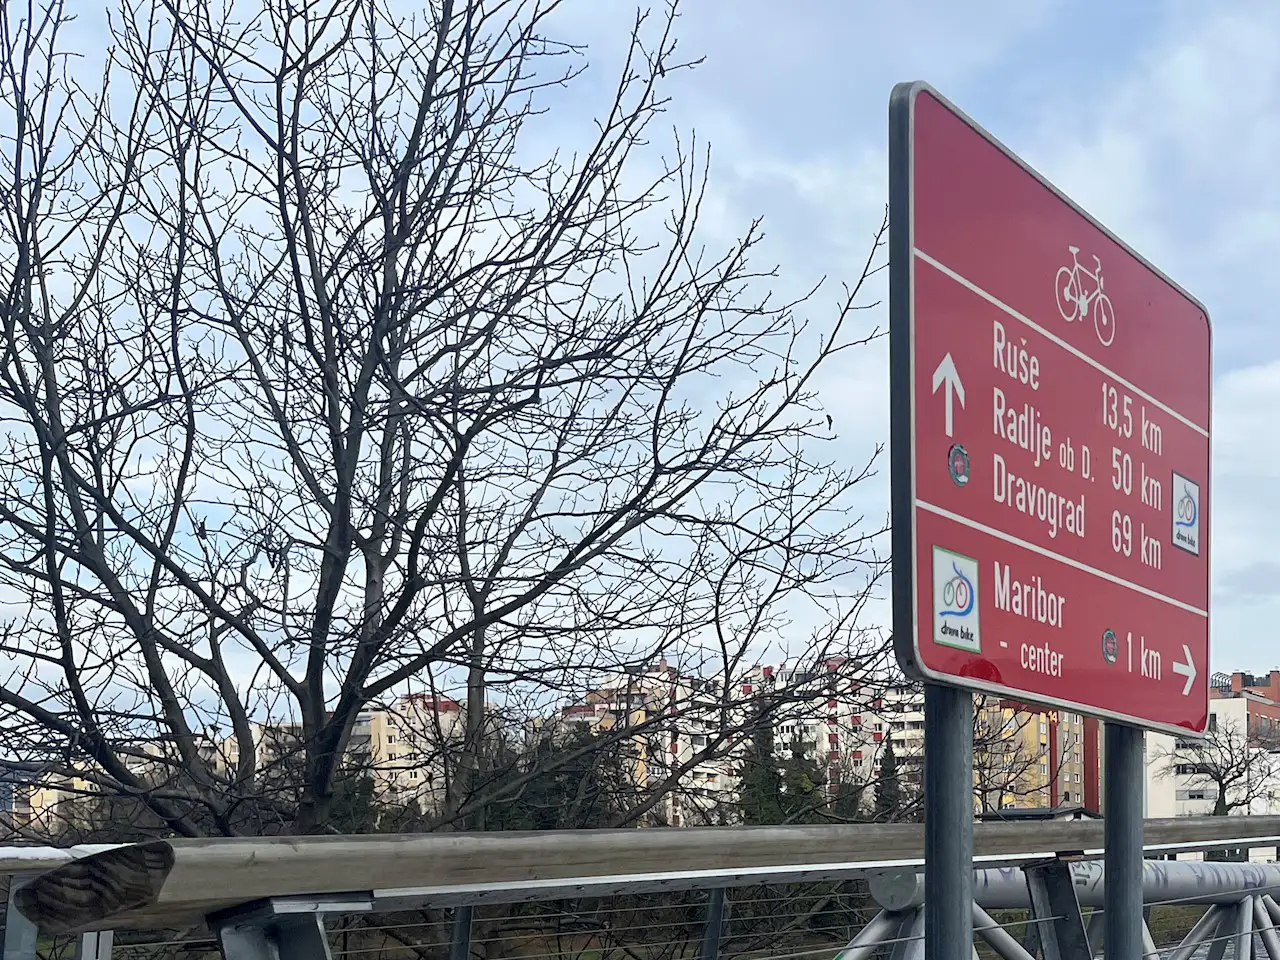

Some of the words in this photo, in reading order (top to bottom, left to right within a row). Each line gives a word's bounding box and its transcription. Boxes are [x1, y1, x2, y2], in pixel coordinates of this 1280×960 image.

[993, 320, 1040, 391] Ruše
[1101, 382, 1133, 439] 13,5
[1141, 406, 1162, 456] km
[993, 386, 1051, 467] Radlje
[1059, 437, 1074, 472] ob
[1081, 445, 1095, 483] D.
[1111, 447, 1132, 496] 50
[1141, 463, 1162, 511] km
[993, 453, 1085, 539] Dravograd
[1111, 510, 1132, 557] 69
[1141, 523, 1162, 570] km
[994, 561, 1066, 628] Maribor
[1020, 641, 1064, 678] center
[1126, 632, 1133, 673] 1
[1141, 635, 1162, 681] km
